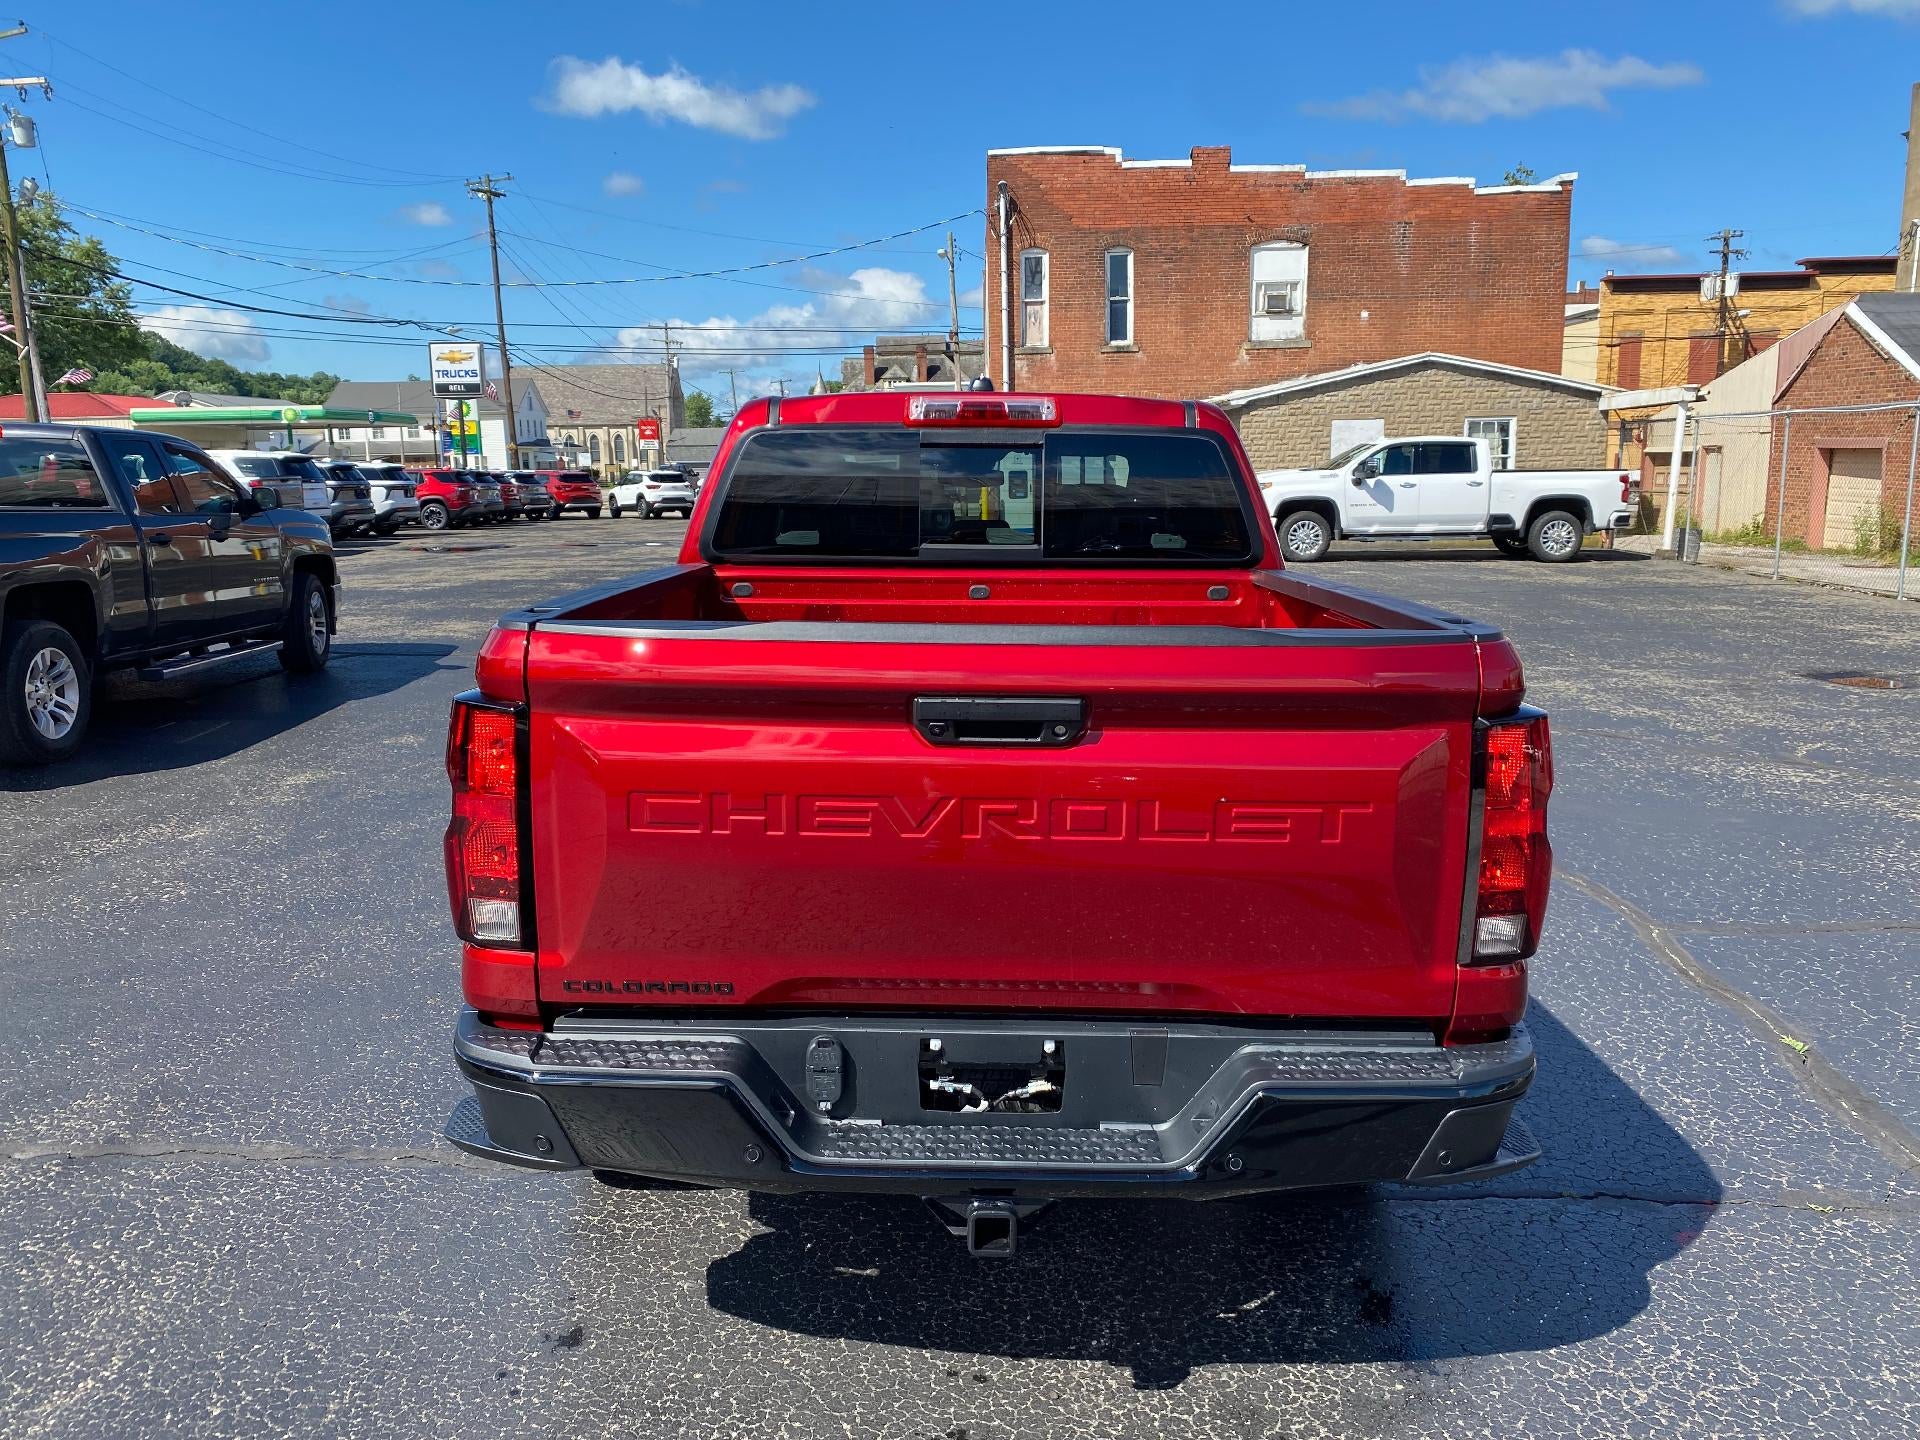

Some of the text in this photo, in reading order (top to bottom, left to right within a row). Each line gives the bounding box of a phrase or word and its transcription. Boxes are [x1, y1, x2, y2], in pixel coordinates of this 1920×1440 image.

[435, 369, 478, 378] TRUCKS
[627, 791, 1374, 844] CHEVROLET
[562, 980, 734, 996] COLORADO
